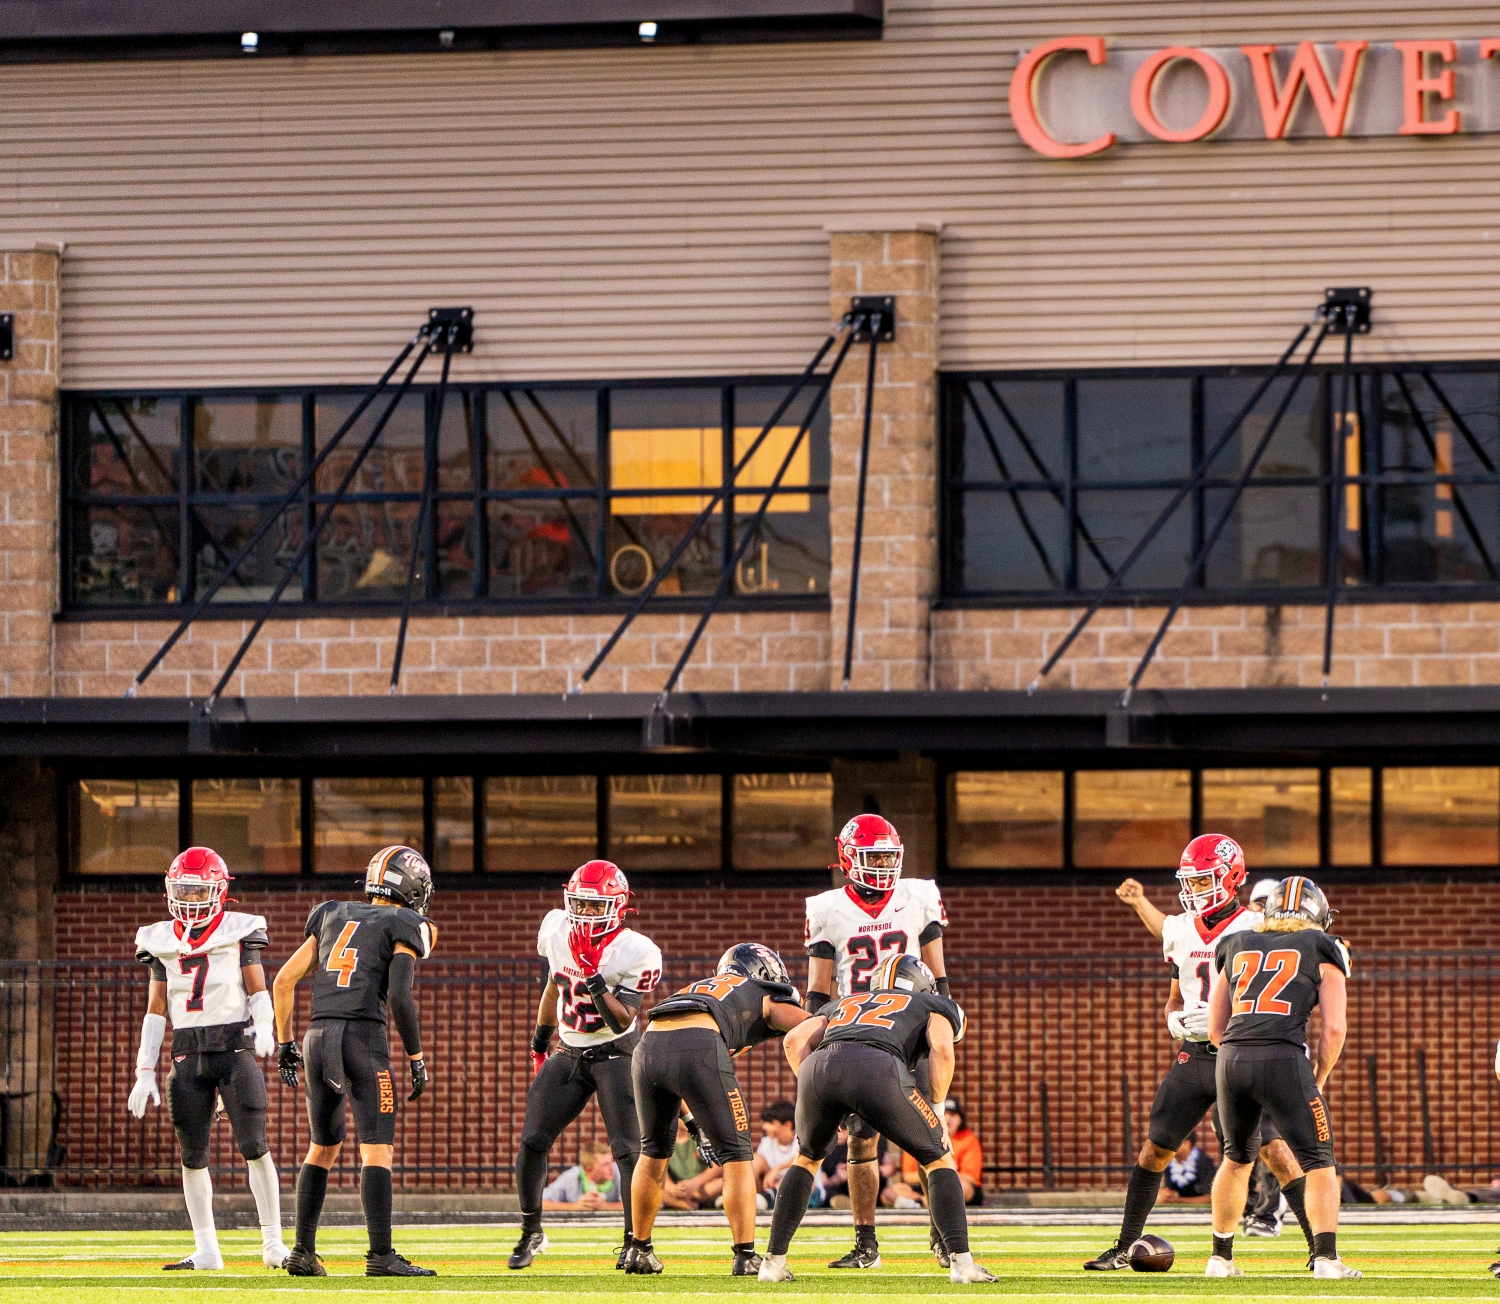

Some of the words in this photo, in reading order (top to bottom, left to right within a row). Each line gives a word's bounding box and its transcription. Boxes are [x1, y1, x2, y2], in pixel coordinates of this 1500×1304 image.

[403, 851, 430, 876] Tiger
[858, 922, 893, 933] NORTHSIDE
[1274, 910, 1308, 921] Riddell
[326, 920, 361, 988] 4
[563, 965, 584, 979] NORTHSI
[1189, 950, 1217, 959] NORTHSI
[178, 951, 210, 1012] 7
[635, 968, 662, 992] 22
[1195, 961, 1211, 1008] 1
[1232, 948, 1302, 1016] 22
[376, 1069, 394, 1114] TIGERS
[728, 1088, 748, 1132] TIGERS
[907, 1089, 939, 1129] TIGERS
[1309, 1096, 1330, 1143] TIGERS
